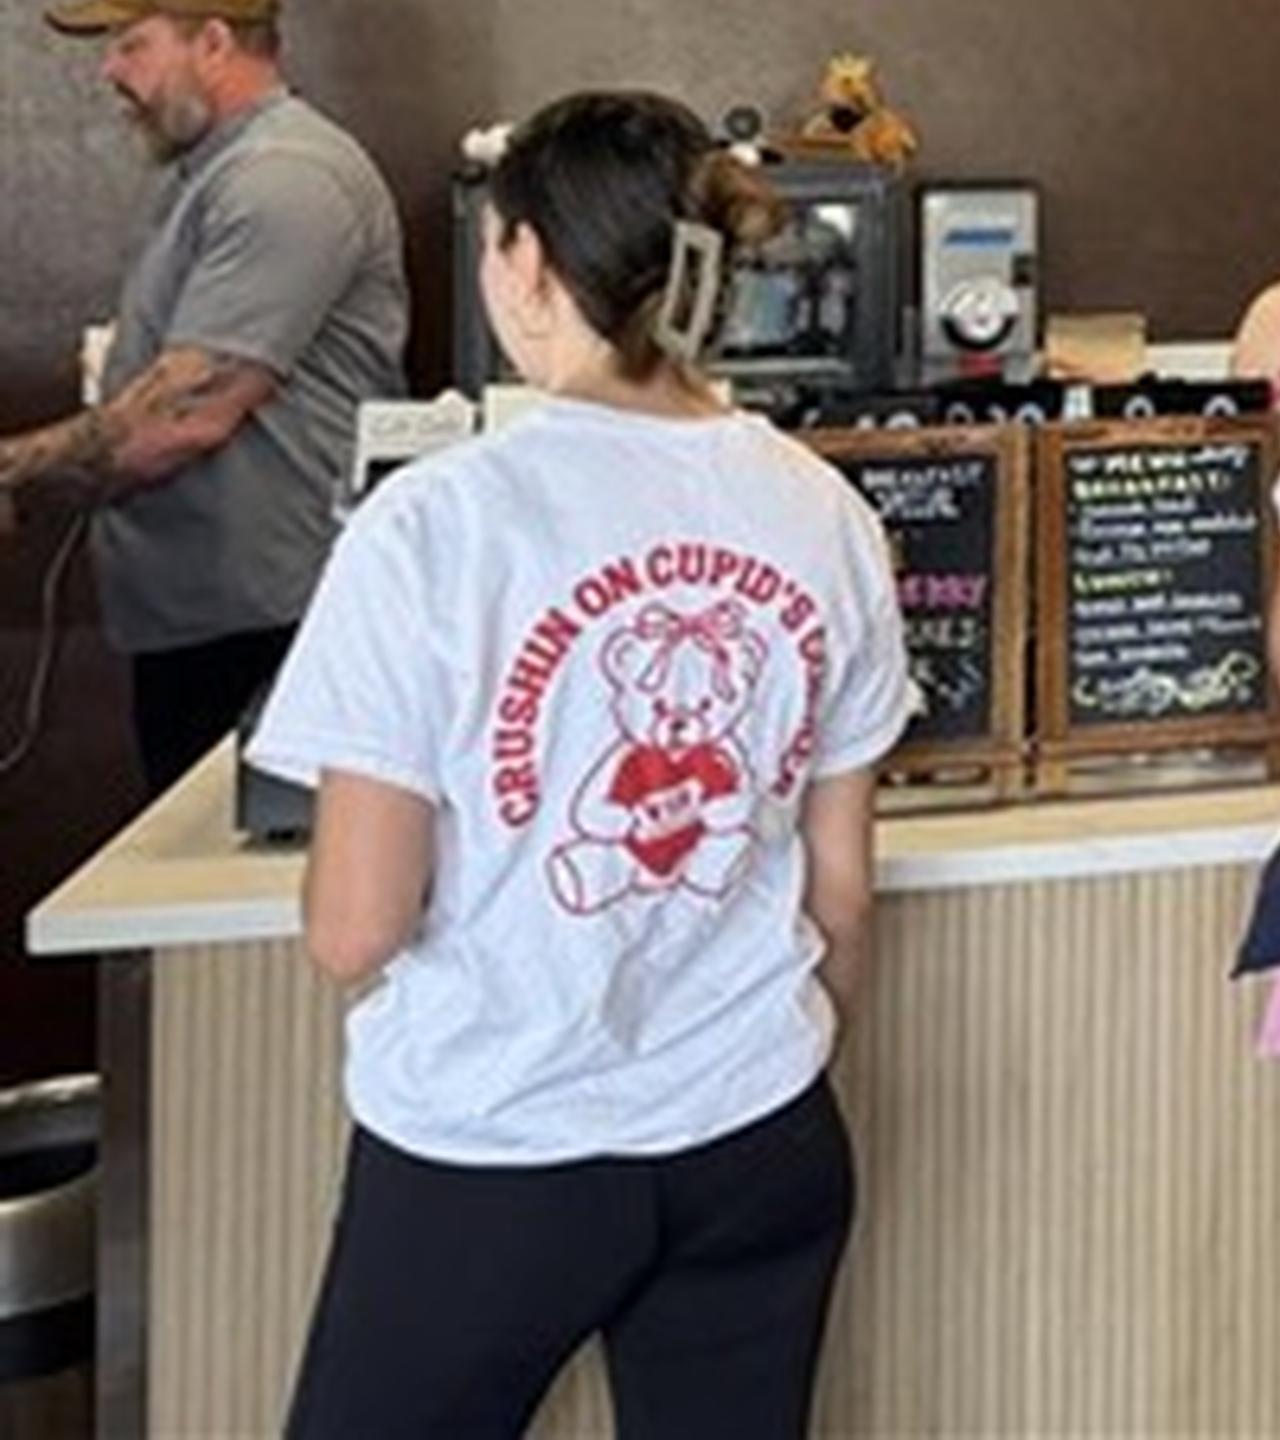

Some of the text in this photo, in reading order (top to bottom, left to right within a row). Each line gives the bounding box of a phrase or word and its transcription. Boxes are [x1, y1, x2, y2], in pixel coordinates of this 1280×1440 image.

[494, 606, 582, 827] CRUSHIN
[573, 556, 642, 618] ON
[645, 544, 816, 632] CUPID'S
